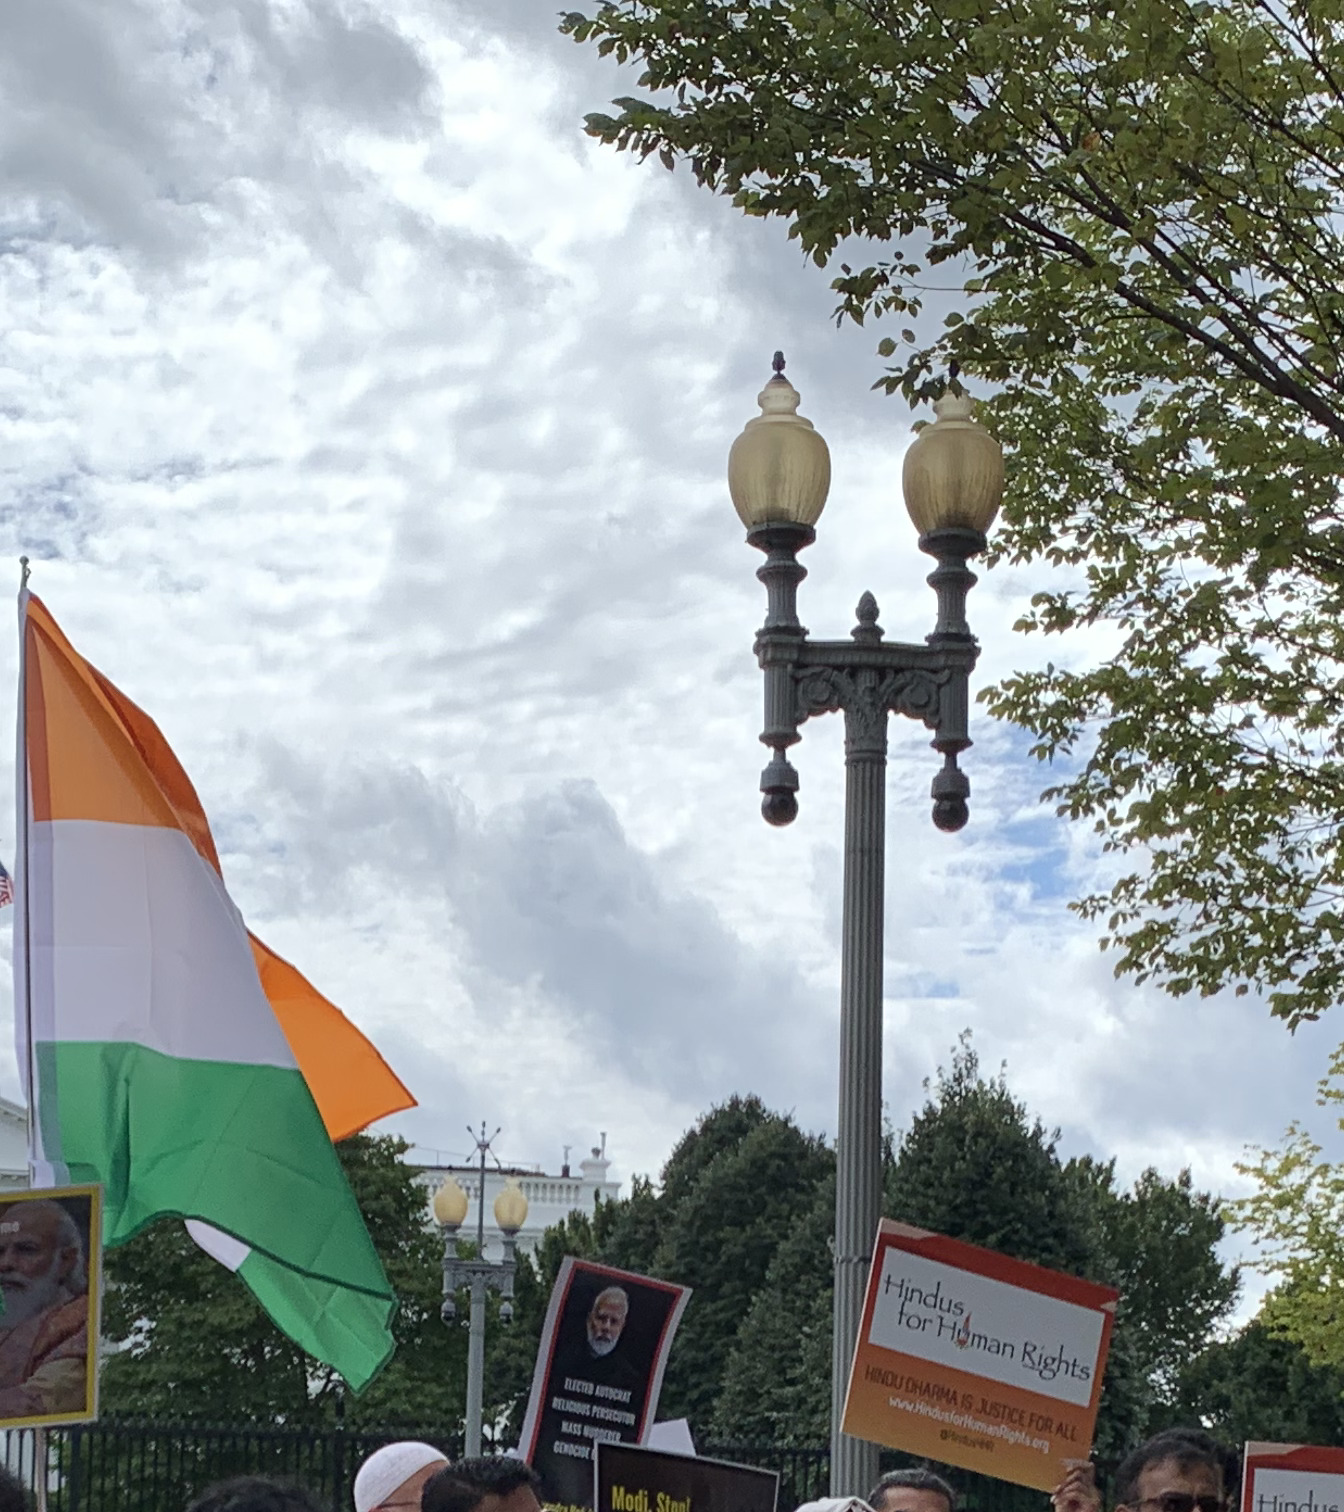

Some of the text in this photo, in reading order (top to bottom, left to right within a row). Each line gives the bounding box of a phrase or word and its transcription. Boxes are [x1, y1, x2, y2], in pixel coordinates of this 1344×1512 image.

[883, 1274, 964, 1317] Hindus
[898, 1300, 1091, 1381] for Human Rights
[564, 1377, 632, 1403] ELECTED AUTOCRAT
[864, 1364, 1077, 1443] HINDU DHARMA IS JUSTICE FOR ALL
[552, 1397, 635, 1426] RELIGIOUS PERSECUTOR
[561, 1420, 582, 1436] MASS
[888, 1396, 1050, 1455] www.HindusforHumanRights.org
[553, 1440, 590, 1460] GENOCIDE
